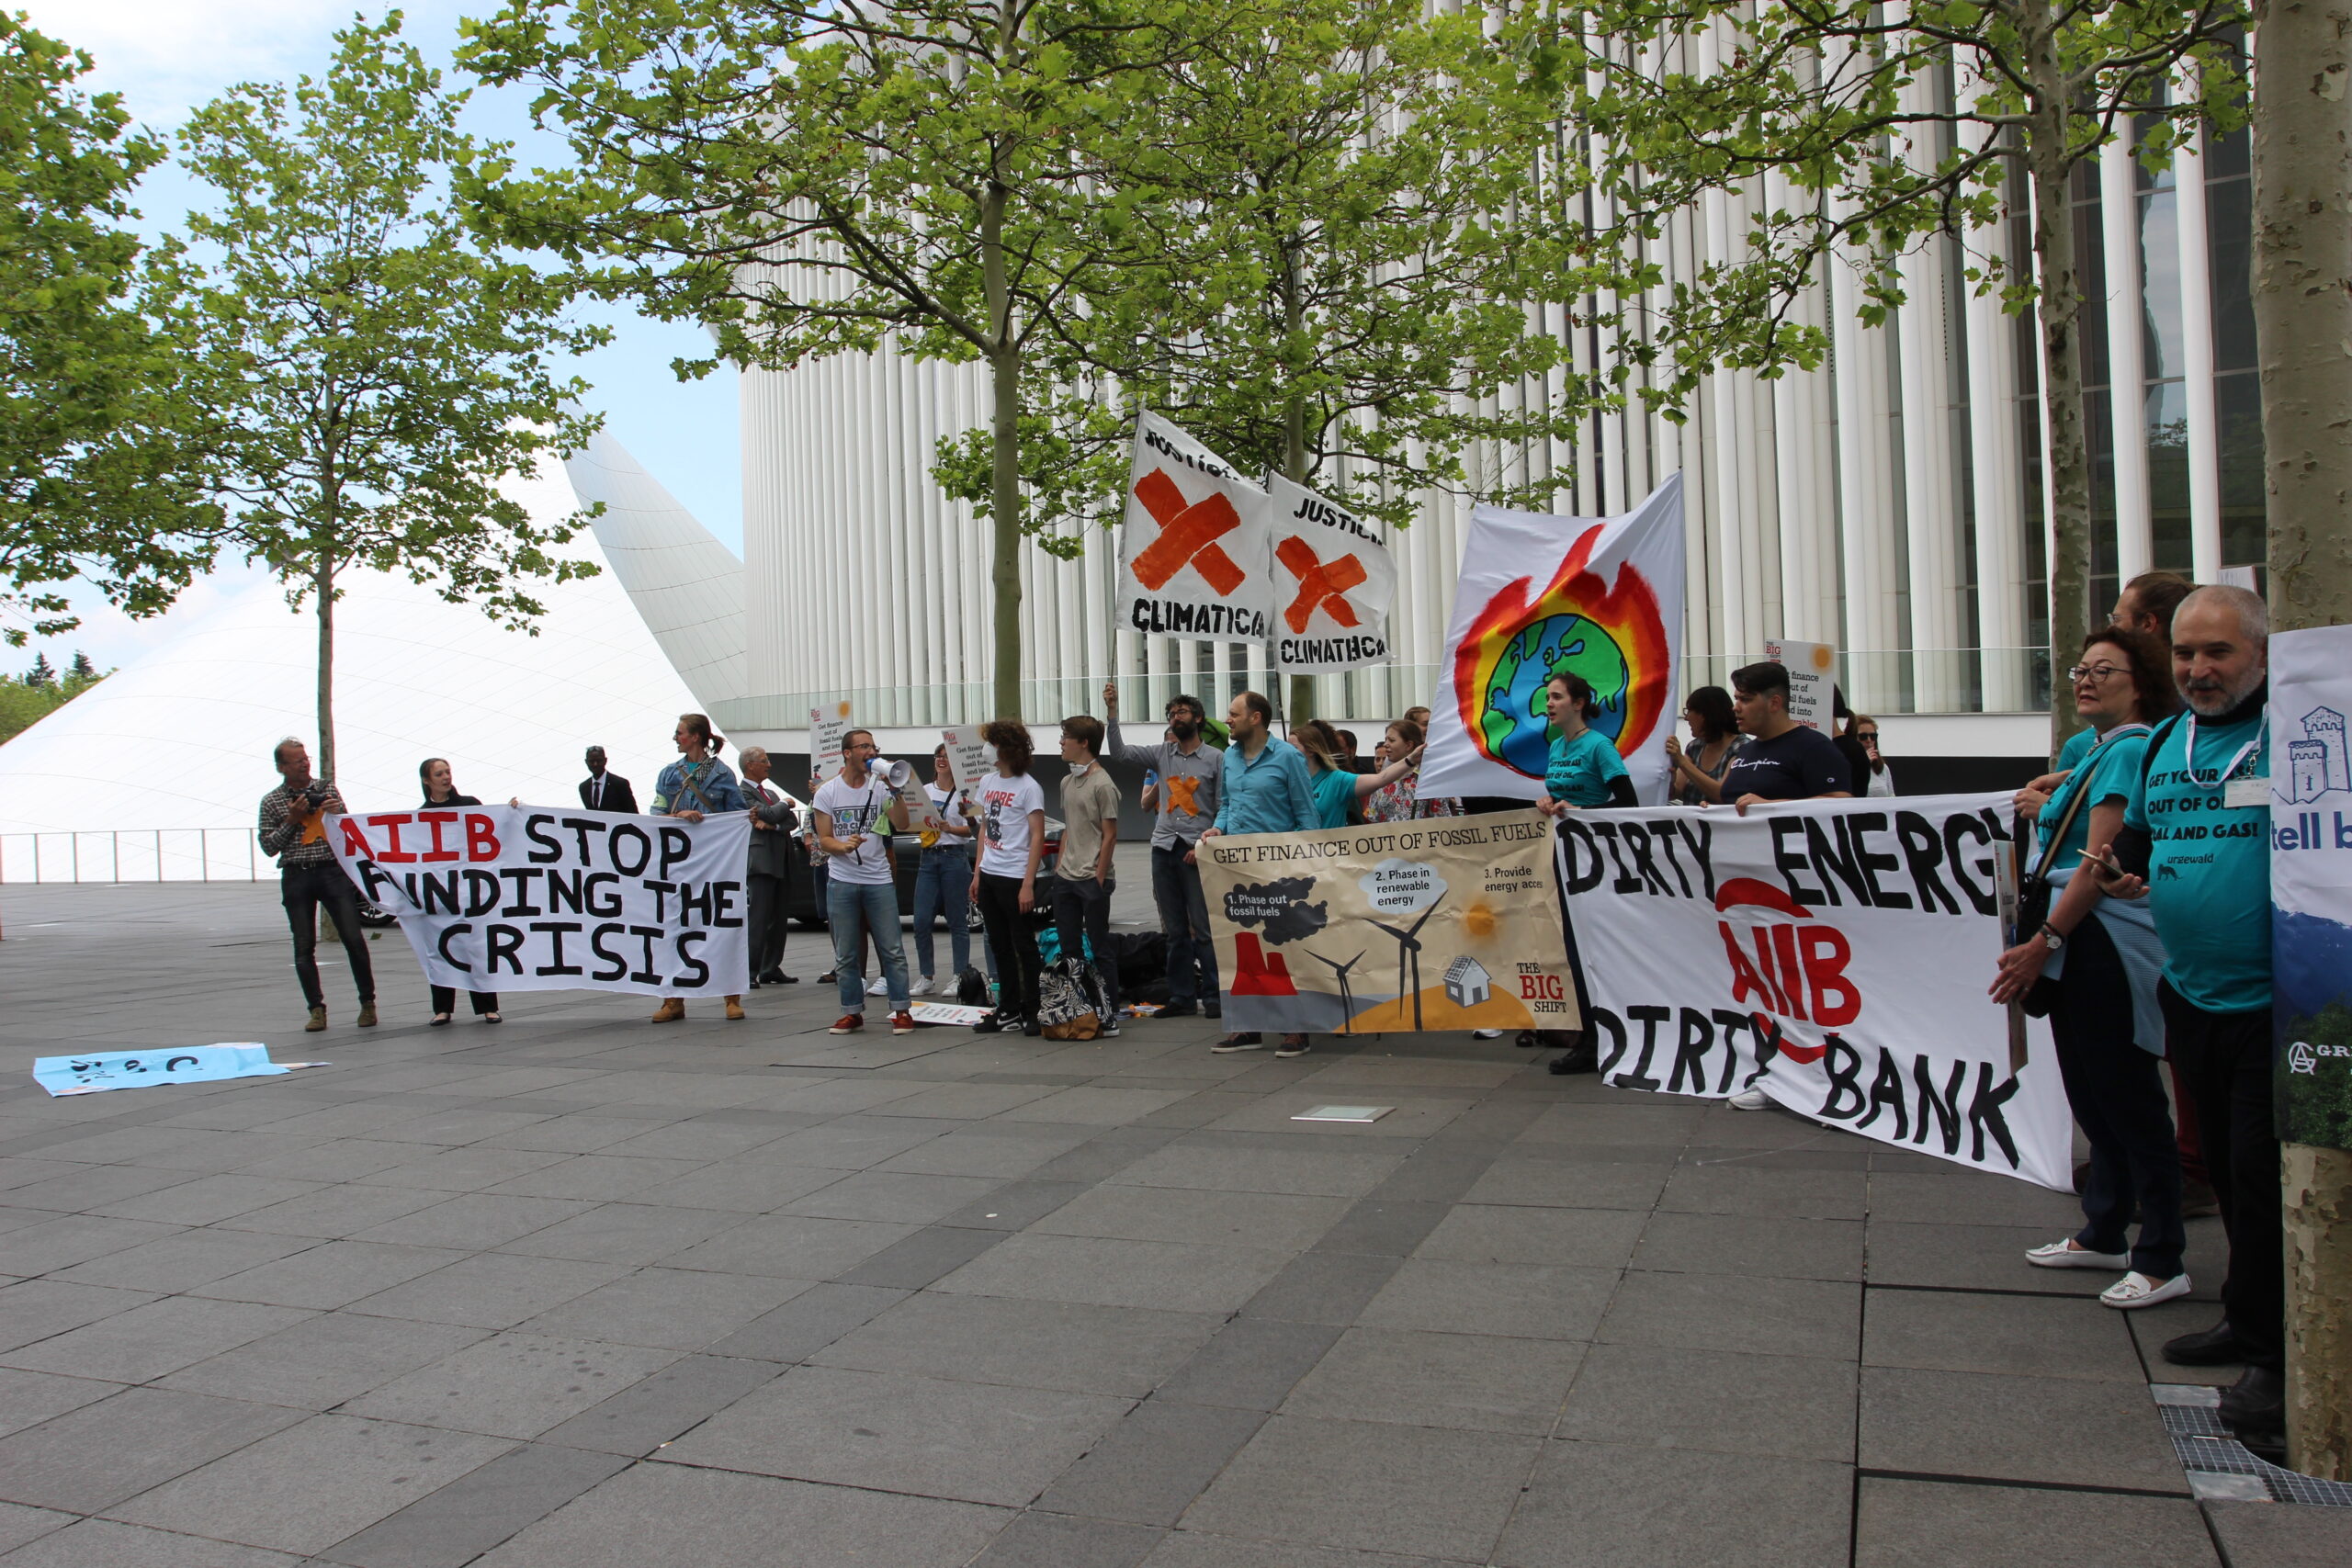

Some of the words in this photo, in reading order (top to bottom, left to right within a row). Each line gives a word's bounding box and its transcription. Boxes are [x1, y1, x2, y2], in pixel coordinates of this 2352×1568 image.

[1132, 597, 1265, 638] CLIMATICA
[1766, 646, 1781, 655] BIG
[1792, 671, 1819, 682] finance
[1798, 695, 1816, 705] fuels
[1797, 706, 1812, 716] into
[1731, 758, 1781, 771] Champion
[2149, 773, 2168, 788] GET
[2171, 769, 2219, 784] YOUR
[985, 790, 1015, 807] MORE
[2148, 798, 2175, 815] OUT
[2179, 797, 2202, 812] OF
[833, 809, 877, 823] YOUH
[2171, 826, 2208, 840] AND
[2212, 823, 2258, 839] GAS!
[339, 811, 501, 863] AIIB
[526, 815, 692, 881] STOP
[1214, 847, 1251, 863] GET
[1257, 840, 1351, 862] FINANCE
[1355, 835, 1396, 854] OUT
[1399, 833, 1423, 850] OF
[1428, 829, 1487, 848] FOSSIL
[1489, 821, 1546, 842] FUELS
[1556, 818, 1716, 903] DIRTY
[2167, 853, 2213, 863] urgewald
[1375, 871, 1385, 881] 2.
[1389, 869, 1418, 880] Phase
[1419, 868, 1430, 877] in
[1485, 869, 1491, 878] 3.
[1495, 865, 1532, 878] Provide
[1377, 880, 1430, 893] renewable
[1485, 882, 1518, 893] energy
[356, 860, 622, 917] FUNDING
[643, 880, 743, 928] THE
[1228, 895, 1237, 905] 1.
[1238, 894, 1266, 905] Phase
[1269, 895, 1287, 905] out
[1378, 896, 1414, 906] energy
[1229, 906, 1255, 916] fossil
[1257, 906, 1280, 917] fuels
[437, 921, 709, 988] CRISIS
[1517, 962, 1541, 974] THE
[1718, 920, 1861, 1027] AIIB
[1519, 975, 1564, 1000] BIG
[1534, 1001, 1566, 1013] SHIFT
[1592, 1005, 1782, 1095] DIRTY
[1817, 1034, 2020, 1170] BANK
